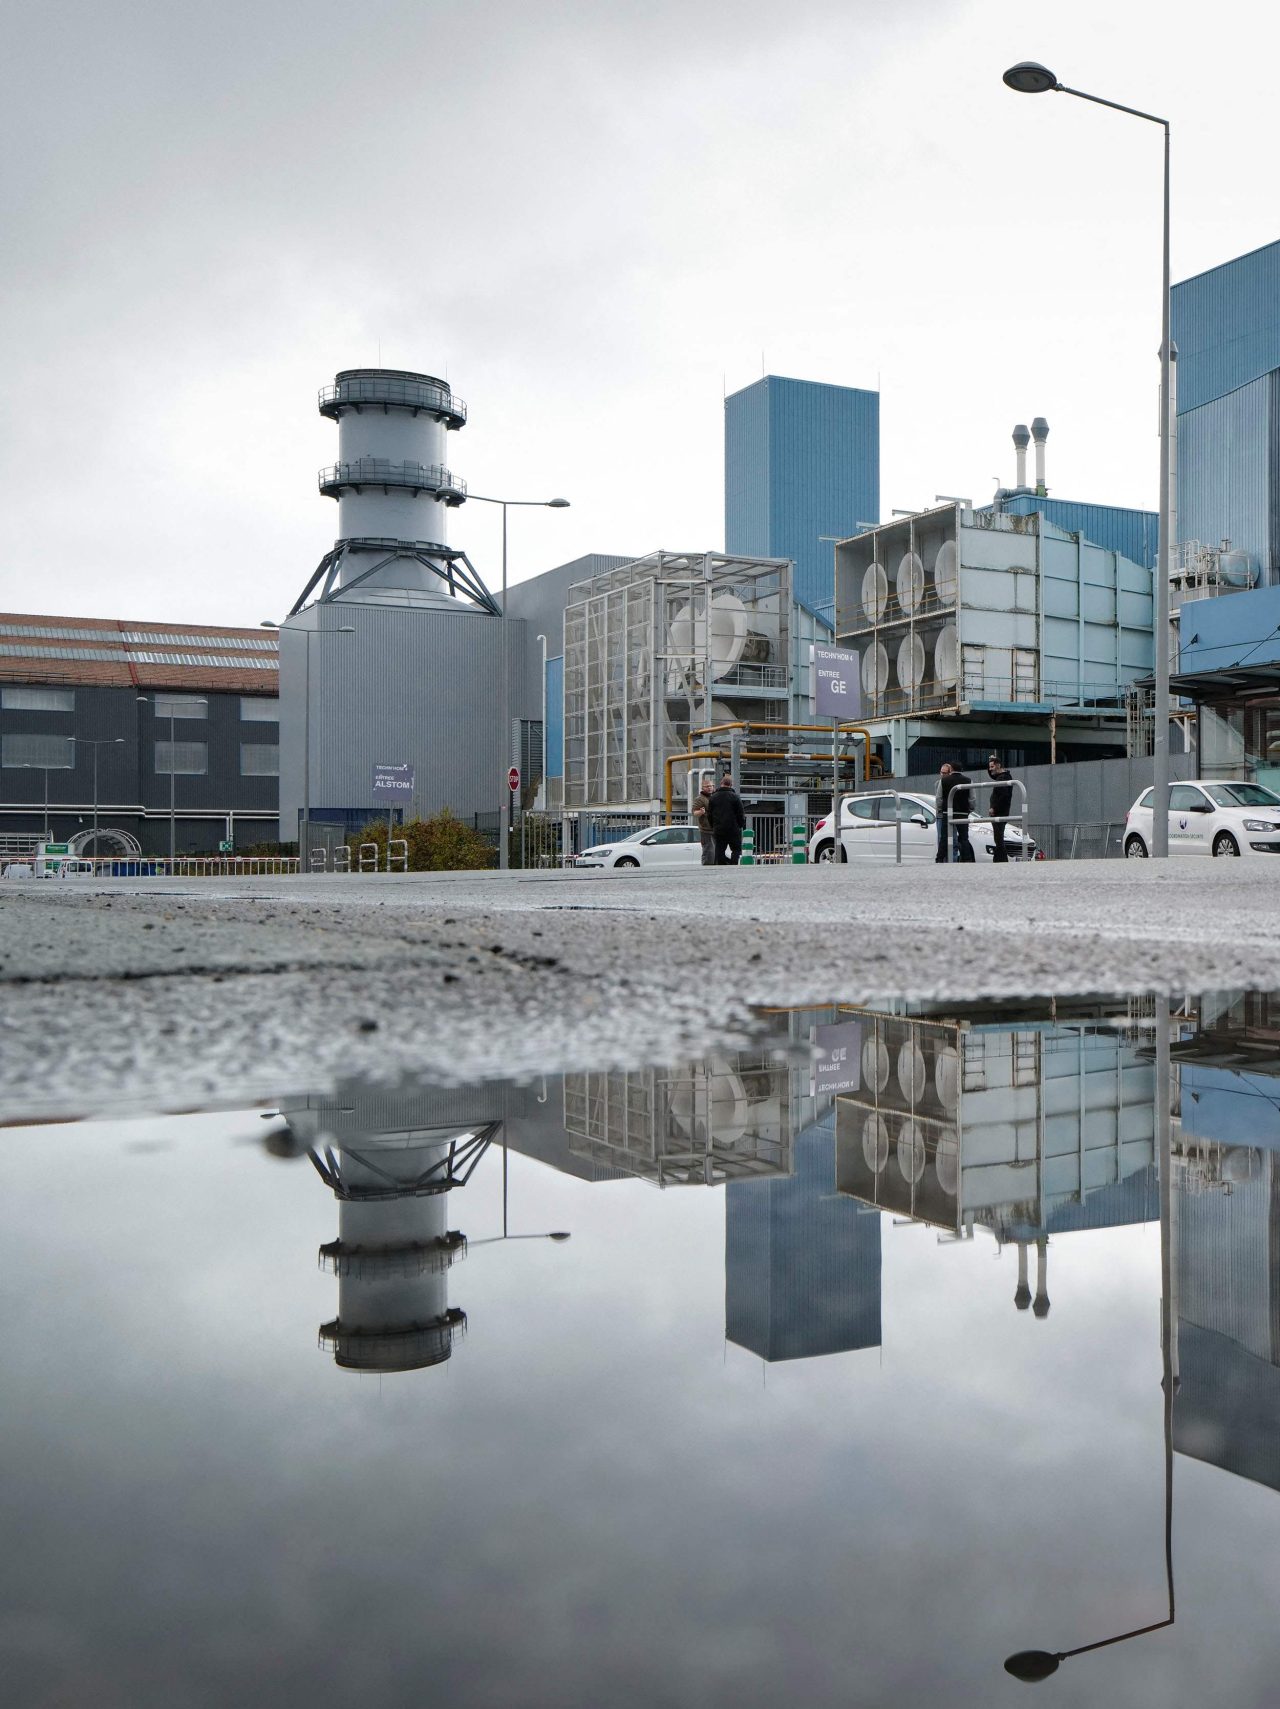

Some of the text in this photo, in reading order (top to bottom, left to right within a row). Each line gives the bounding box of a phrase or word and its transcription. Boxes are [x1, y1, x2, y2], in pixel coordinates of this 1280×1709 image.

[831, 679, 847, 695] GE
[509, 775, 519, 783] STOP
[375, 780, 410, 789] ALSTOM
